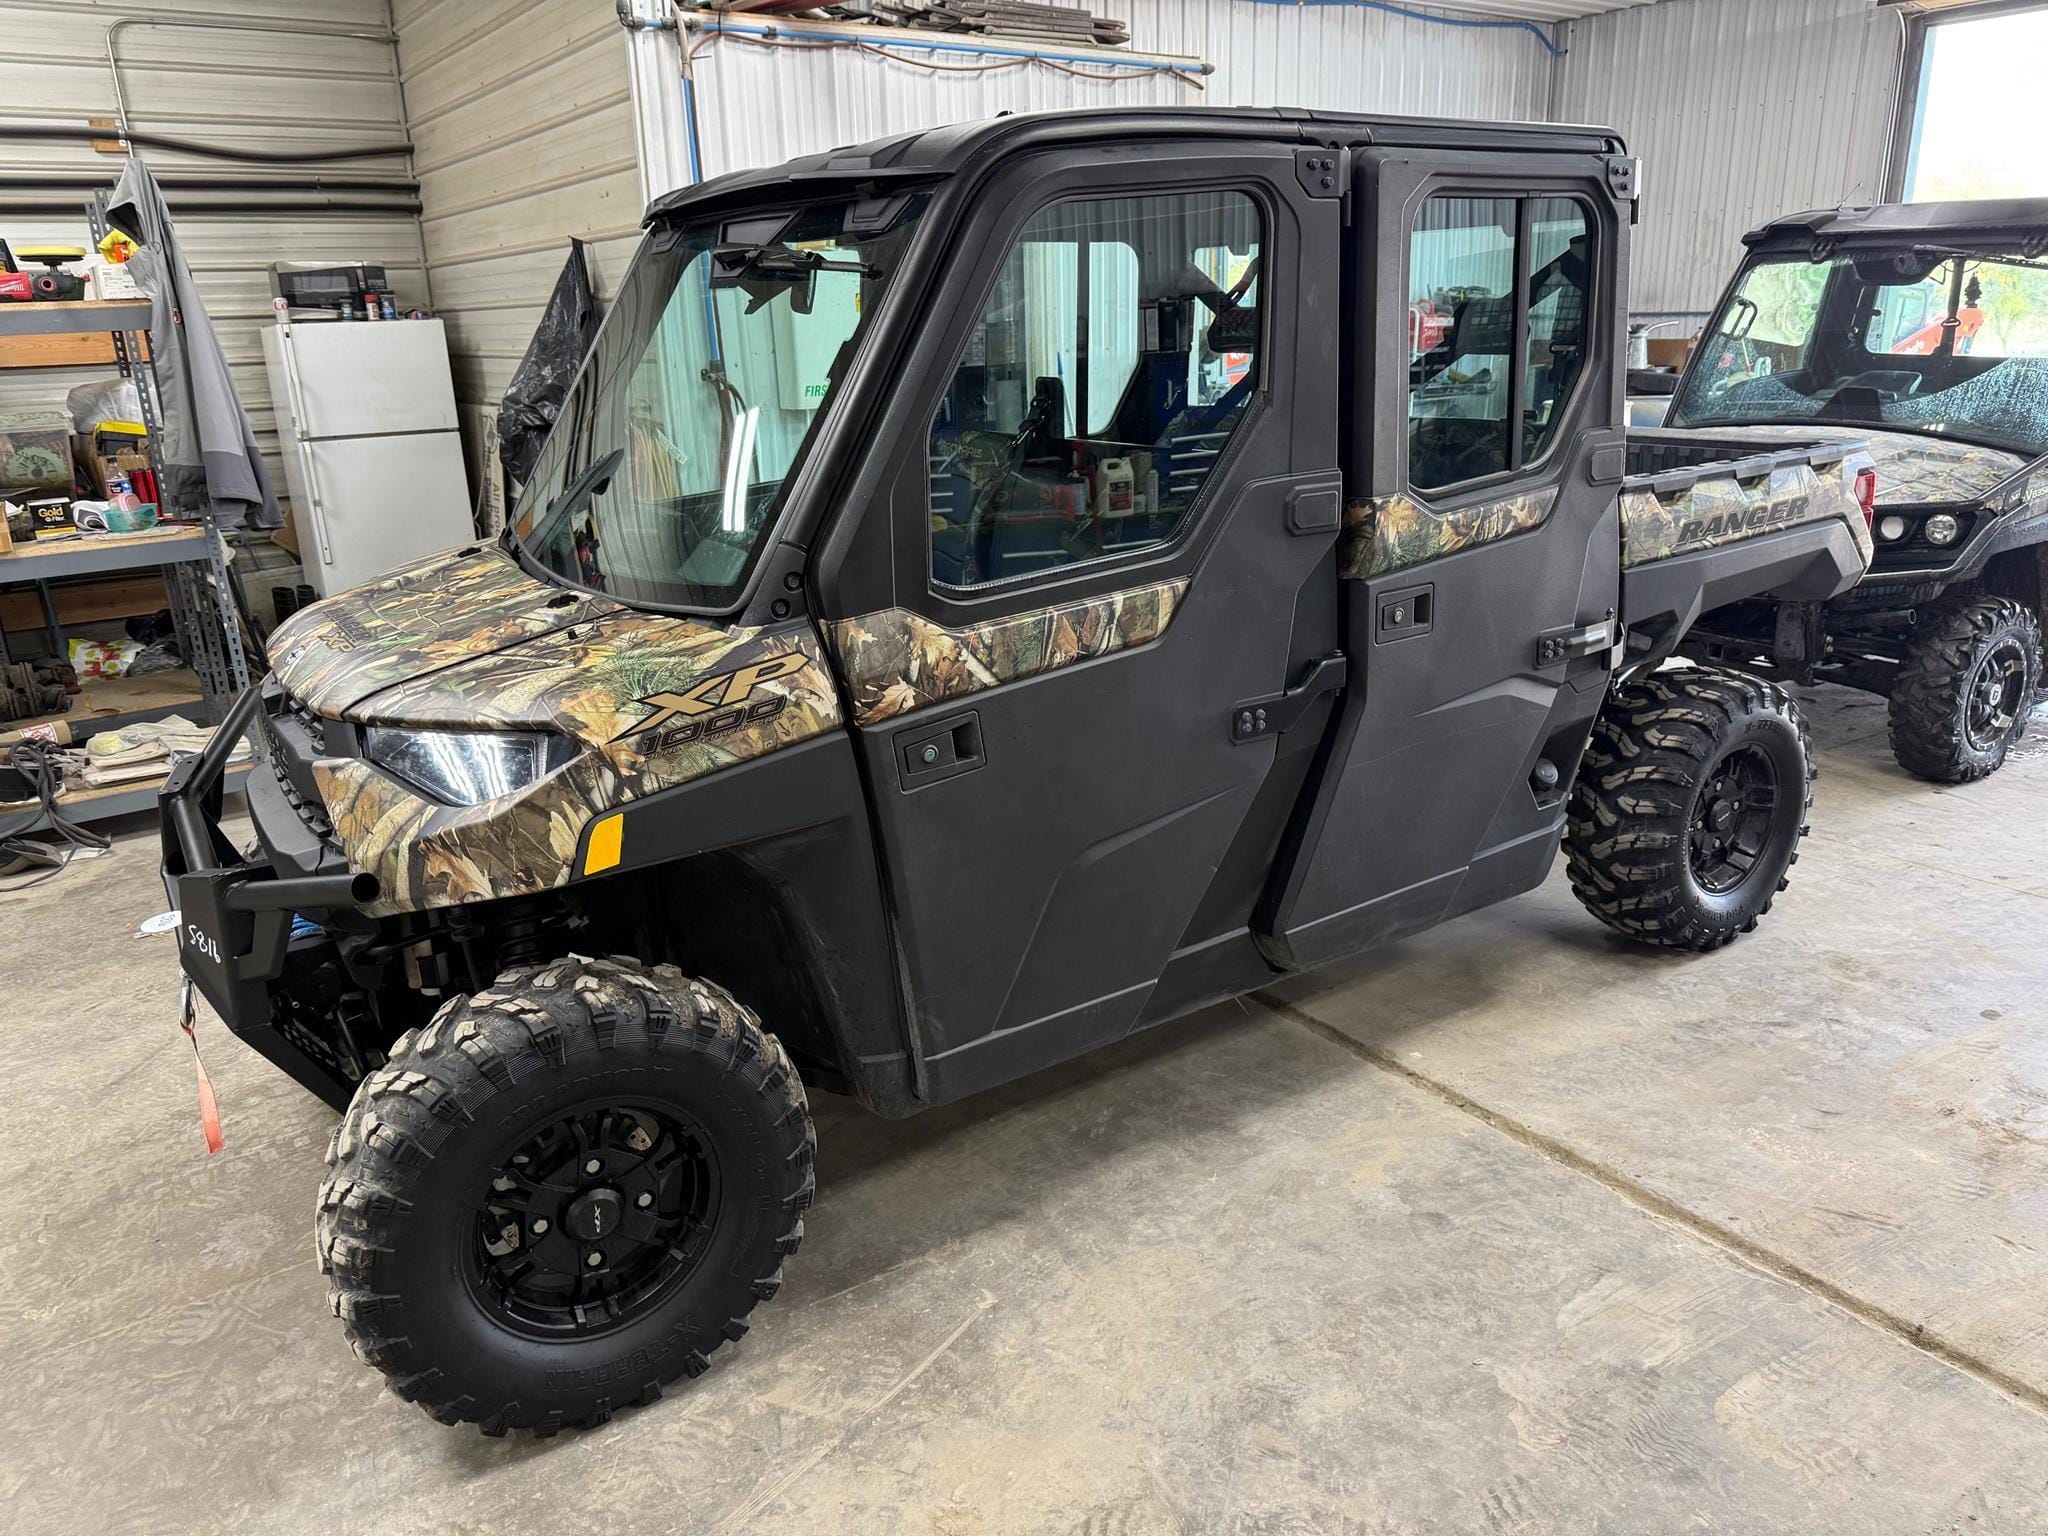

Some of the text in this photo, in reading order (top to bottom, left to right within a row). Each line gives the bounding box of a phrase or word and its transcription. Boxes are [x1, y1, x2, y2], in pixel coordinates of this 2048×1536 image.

[38, 507, 64, 518] Gold
[1674, 496, 1809, 544] RANGER
[318, 631, 355, 653] XP
[605, 651, 810, 744] XP
[642, 695, 787, 755] 1000
[543, 1312, 700, 1392] X-TERRAIN
